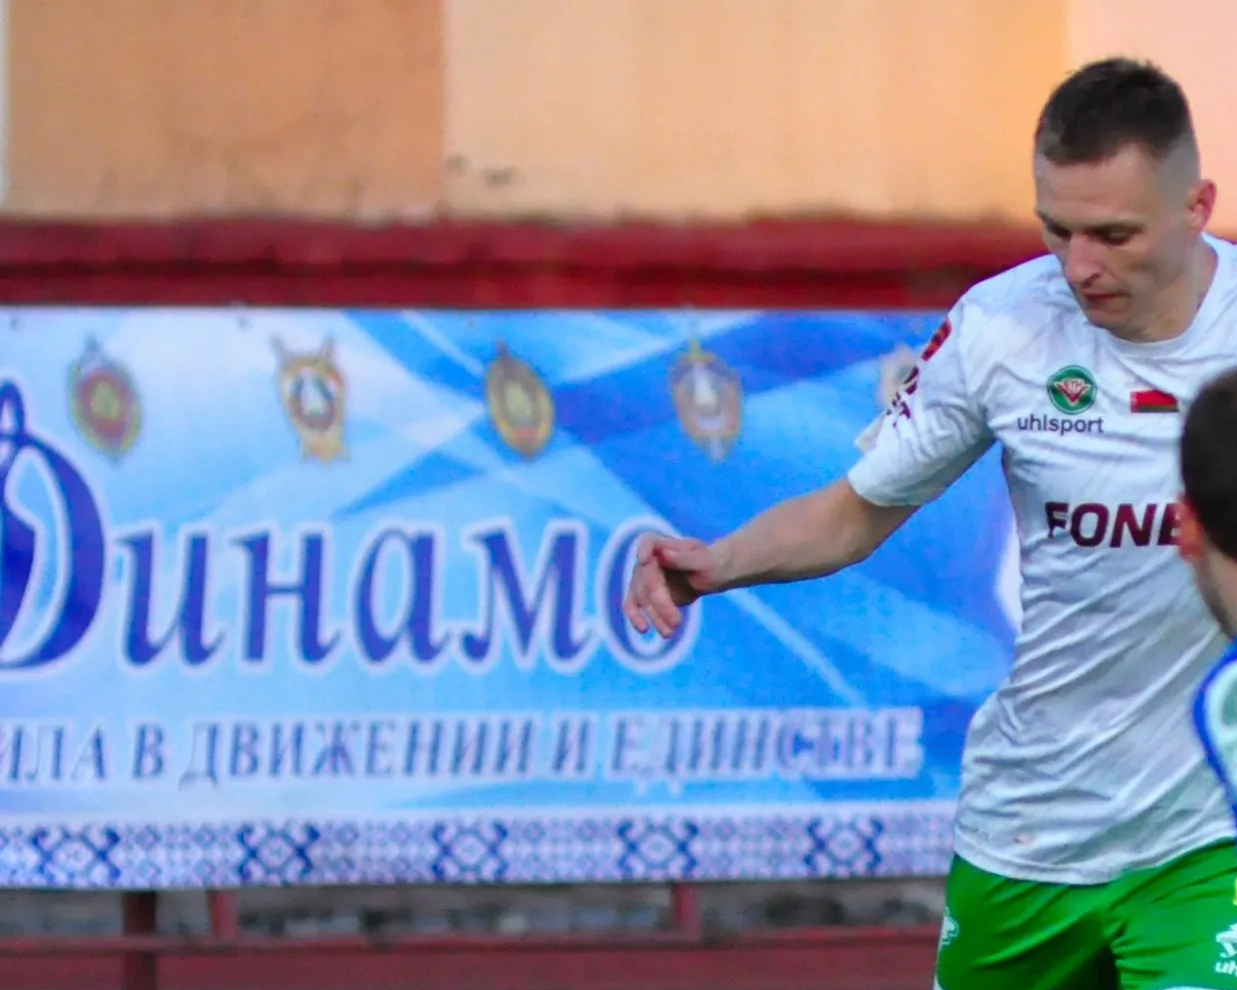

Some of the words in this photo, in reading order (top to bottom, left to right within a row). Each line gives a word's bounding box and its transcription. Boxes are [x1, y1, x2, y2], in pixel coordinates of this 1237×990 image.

[1017, 413, 1104, 435] uhlsport
[132, 721, 166, 780] В
[178, 718, 535, 791] ДВИЖЕНИИ
[551, 719, 590, 776] И
[611, 713, 918, 788] ЕДИНСТВЕ
